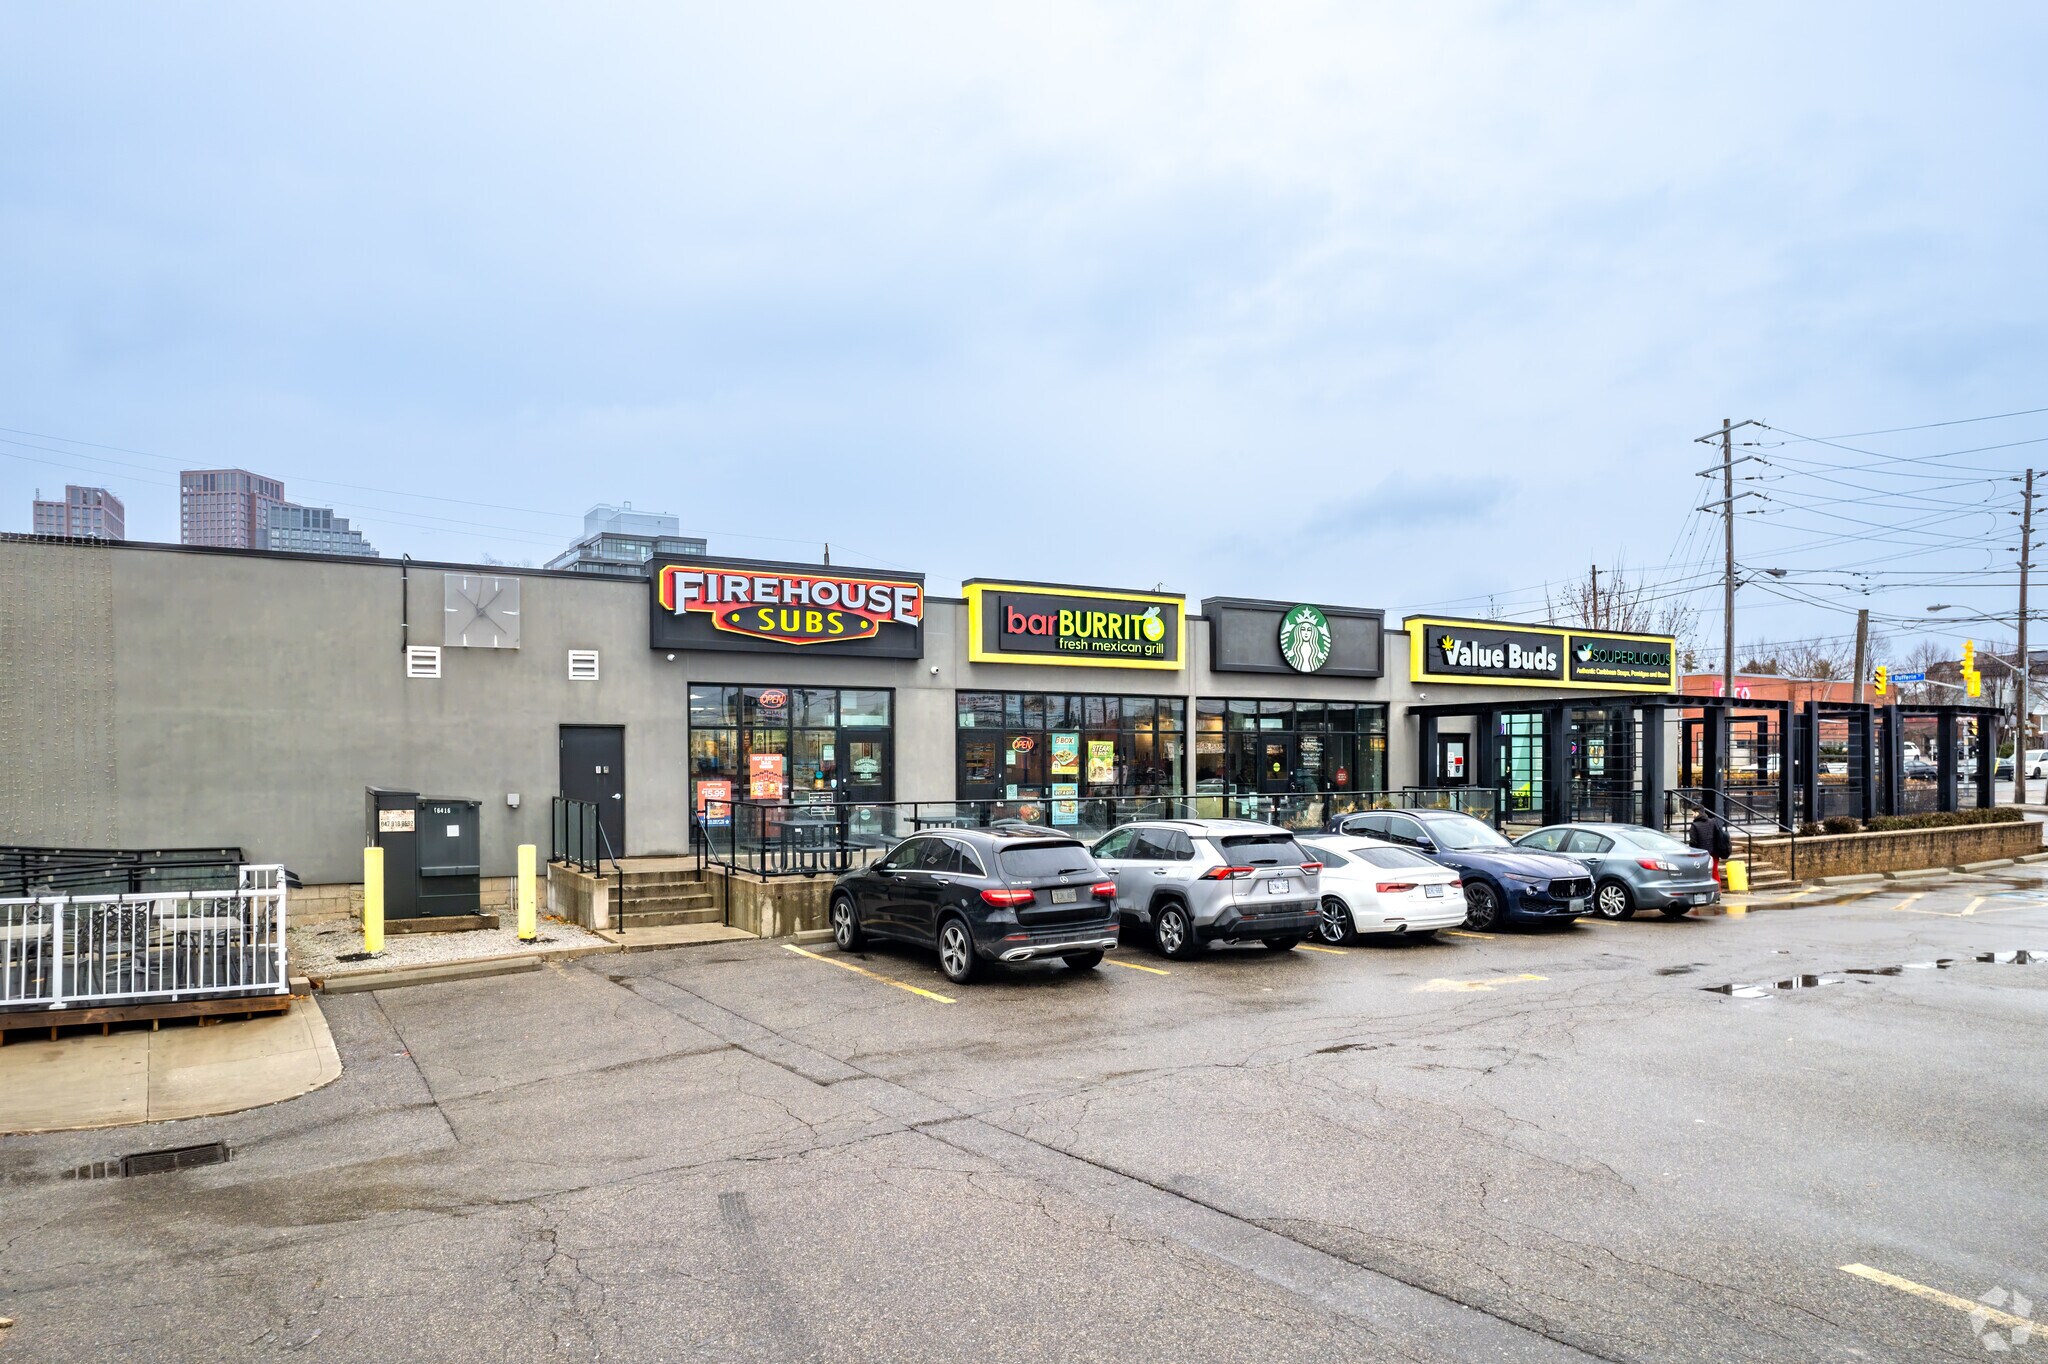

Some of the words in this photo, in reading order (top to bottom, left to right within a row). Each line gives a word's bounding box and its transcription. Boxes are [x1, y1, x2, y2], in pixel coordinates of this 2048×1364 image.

[674, 571, 919, 627] FIREHOUSE
[758, 608, 844, 634] SUBS
[1059, 638, 1088, 650] fresh
[1092, 641, 1142, 654] mexican
[1144, 643, 1164, 656] grill
[1444, 639, 1504, 669] Value
[1508, 643, 1557, 671] Buds
[1592, 648, 1671, 667] SOUPERLICIOUS
[761, 694, 785, 704] OPEN
[1014, 740, 1033, 750] OPEN
